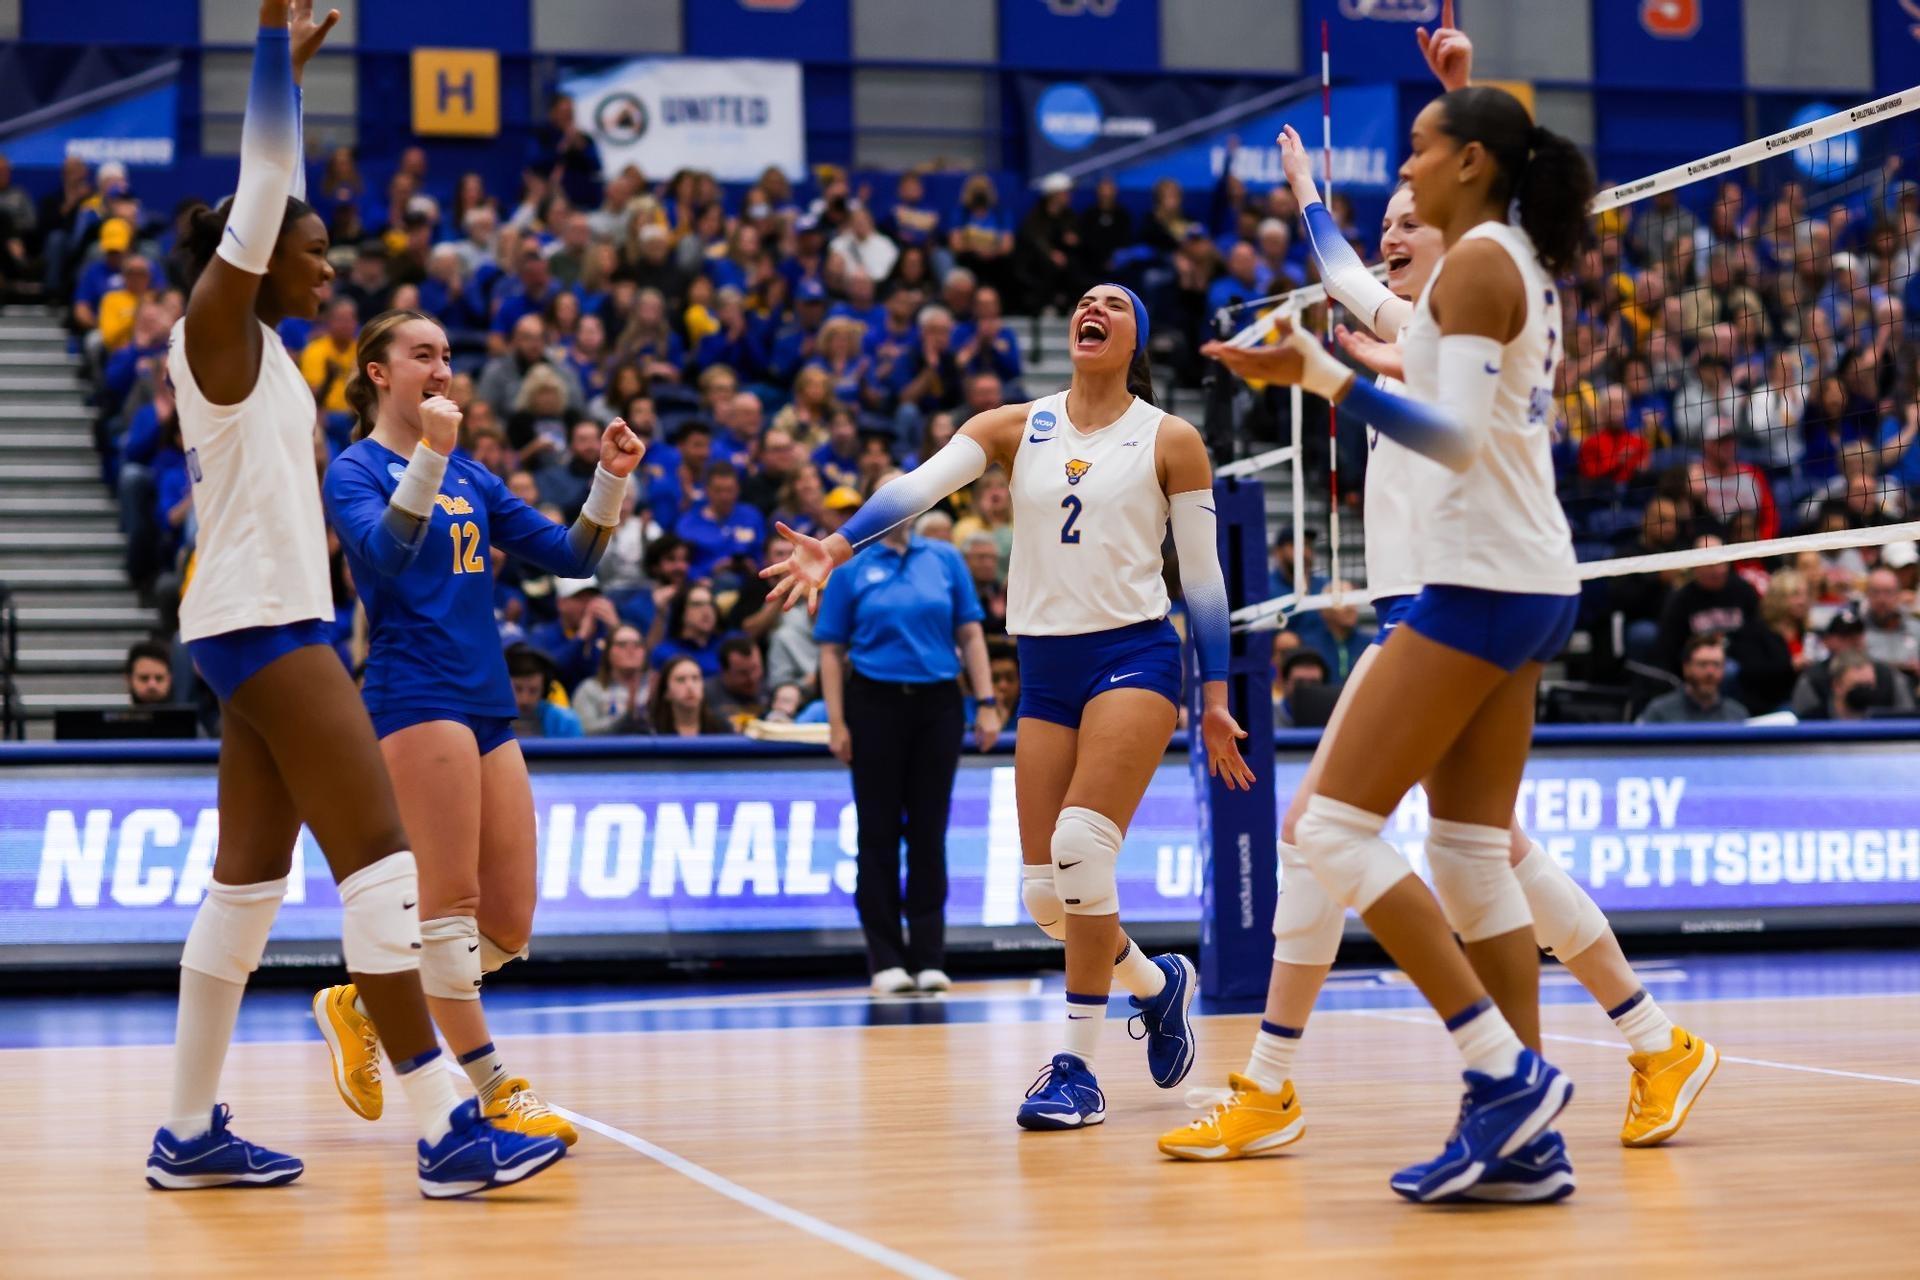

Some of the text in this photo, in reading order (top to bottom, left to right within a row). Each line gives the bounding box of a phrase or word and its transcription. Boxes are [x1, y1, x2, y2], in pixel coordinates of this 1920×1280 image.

[437, 69, 475, 116] H
[660, 96, 769, 127] UNITED
[1061, 494, 1083, 544] 2
[450, 520, 485, 575] 12
[1396, 776, 1686, 832] HTED BY
[33, 808, 307, 908] NCA
[1589, 830, 1920, 889] PITTSBURGH
